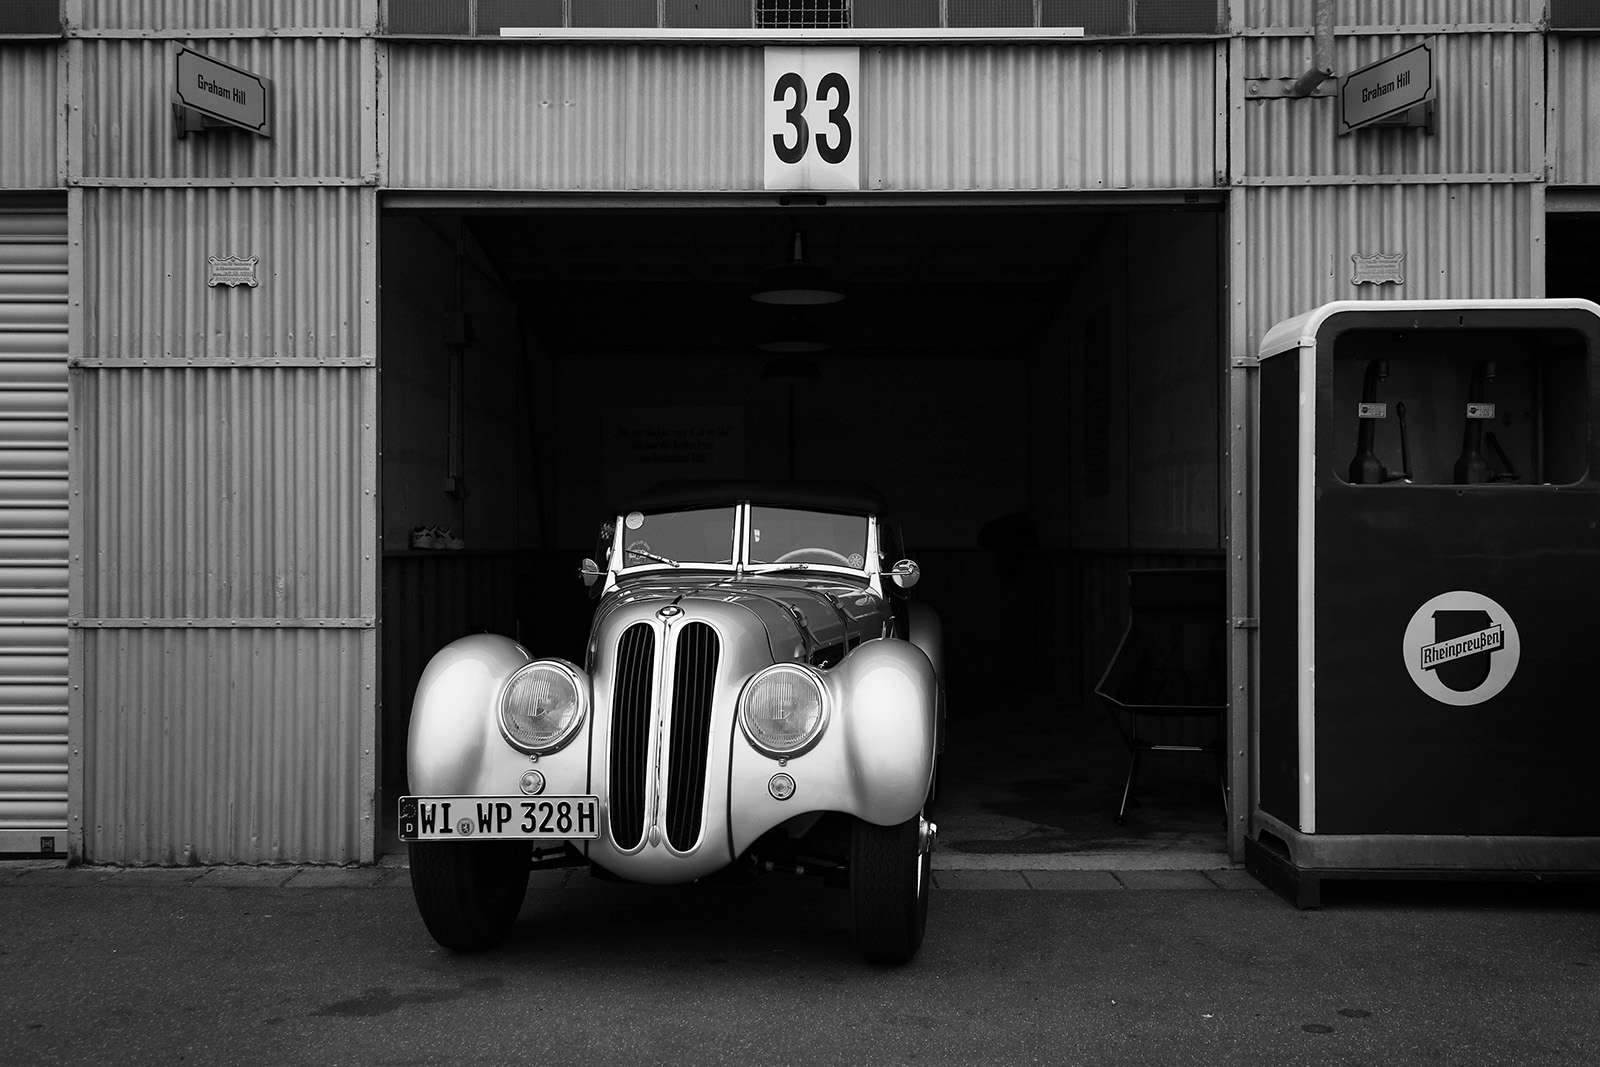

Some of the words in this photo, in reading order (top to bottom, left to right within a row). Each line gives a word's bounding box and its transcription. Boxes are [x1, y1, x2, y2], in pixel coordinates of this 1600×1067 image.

[198, 74, 231, 100] Graham
[232, 88, 246, 106] Hill
[1362, 81, 1395, 103] Graham
[1396, 70, 1411, 89] Hill
[773, 72, 852, 164] 33
[1423, 631, 1500, 664] Rheinpreußen
[405, 823, 413, 833] D
[420, 802, 454, 834] WI
[476, 802, 512, 833] WP
